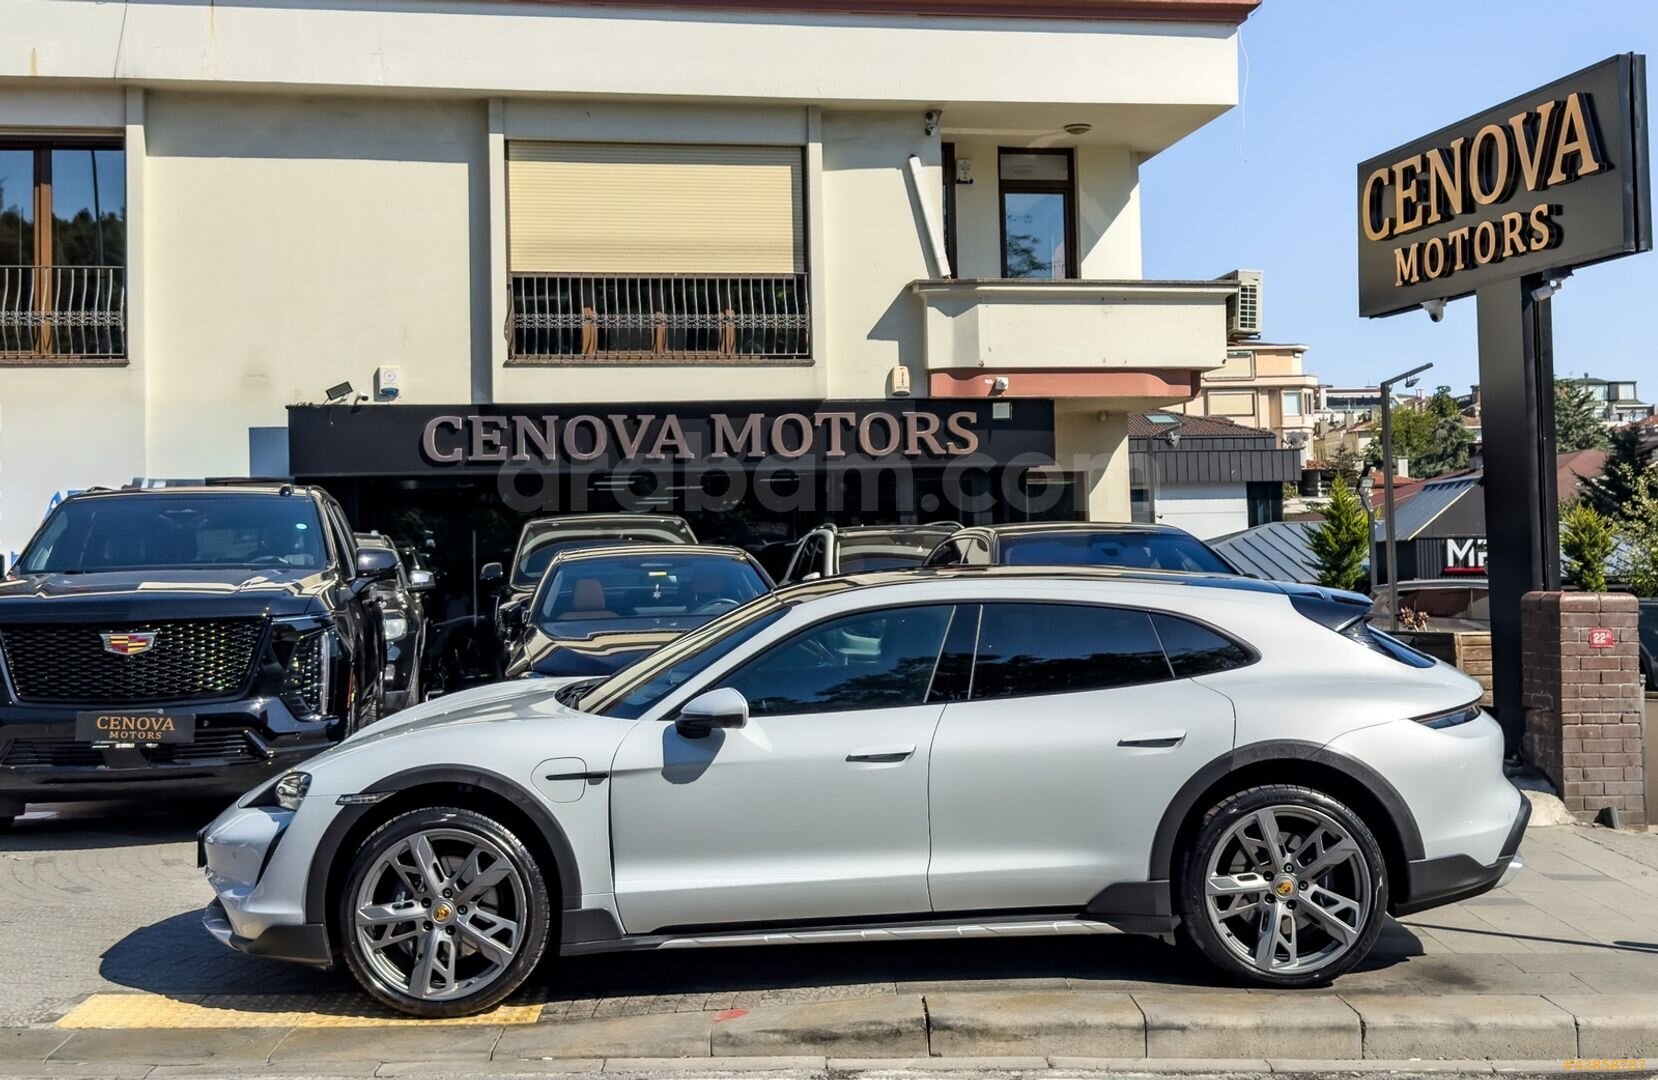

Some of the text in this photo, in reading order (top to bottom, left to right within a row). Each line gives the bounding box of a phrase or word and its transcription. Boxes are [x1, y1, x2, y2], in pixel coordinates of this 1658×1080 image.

[1362, 92, 1599, 241] CENOVA
[1394, 204, 1550, 287] MOTORS
[422, 411, 979, 462] CENOVA MOTORS
[96, 716, 176, 731] CENOVA
[109, 731, 162, 740] MOTORS
